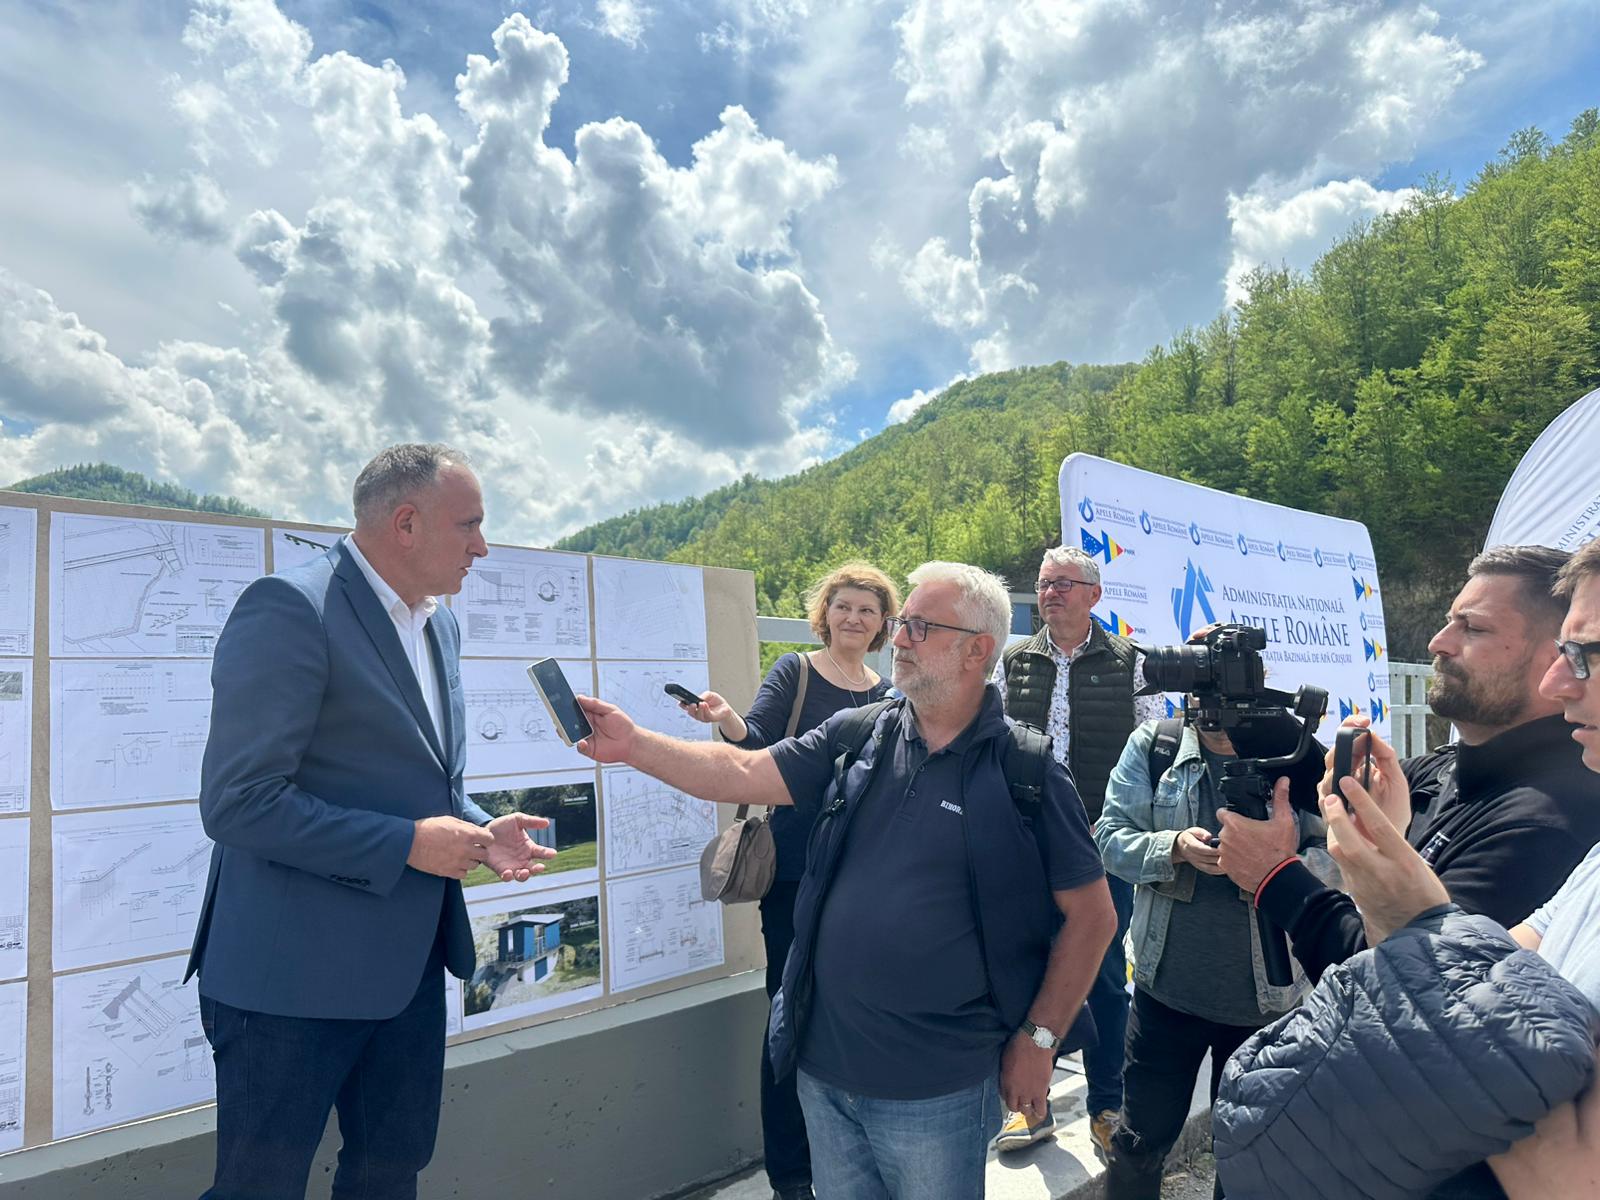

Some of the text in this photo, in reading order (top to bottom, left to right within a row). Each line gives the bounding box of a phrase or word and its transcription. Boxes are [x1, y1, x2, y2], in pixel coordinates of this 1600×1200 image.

[1554, 493, 1600, 550] MINISTRA
[1104, 586, 1122, 597] APELE
[1283, 615, 1351, 647] ROMÂNE
[1312, 653, 1320, 663] DE
[1154, 746, 1170, 756] FILA
